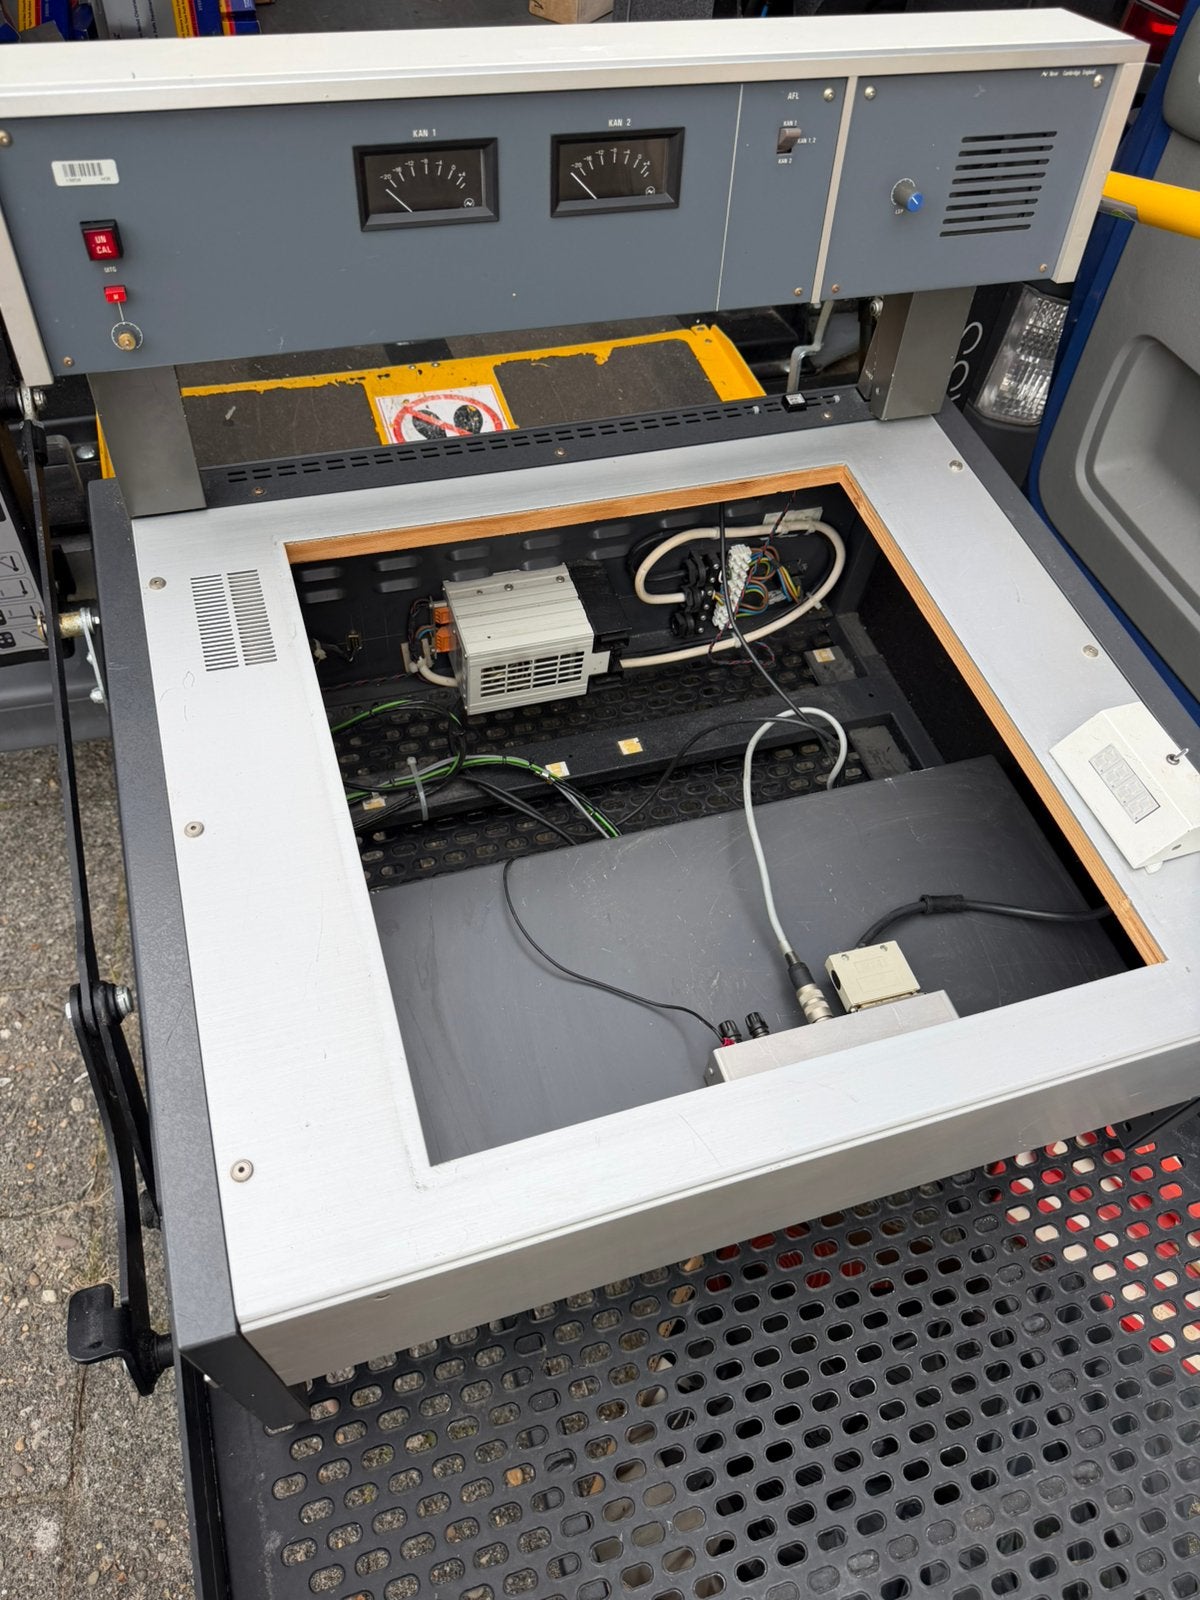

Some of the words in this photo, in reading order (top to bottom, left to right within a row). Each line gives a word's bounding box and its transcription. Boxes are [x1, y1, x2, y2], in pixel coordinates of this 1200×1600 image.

[787, 92, 799, 100] AFL
[608, 118, 623, 127] KAN
[626, 118, 631, 126] 2
[412, 129, 428, 138] KAN
[95, 235, 106, 244] UN
[96, 246, 112, 254] CAL
